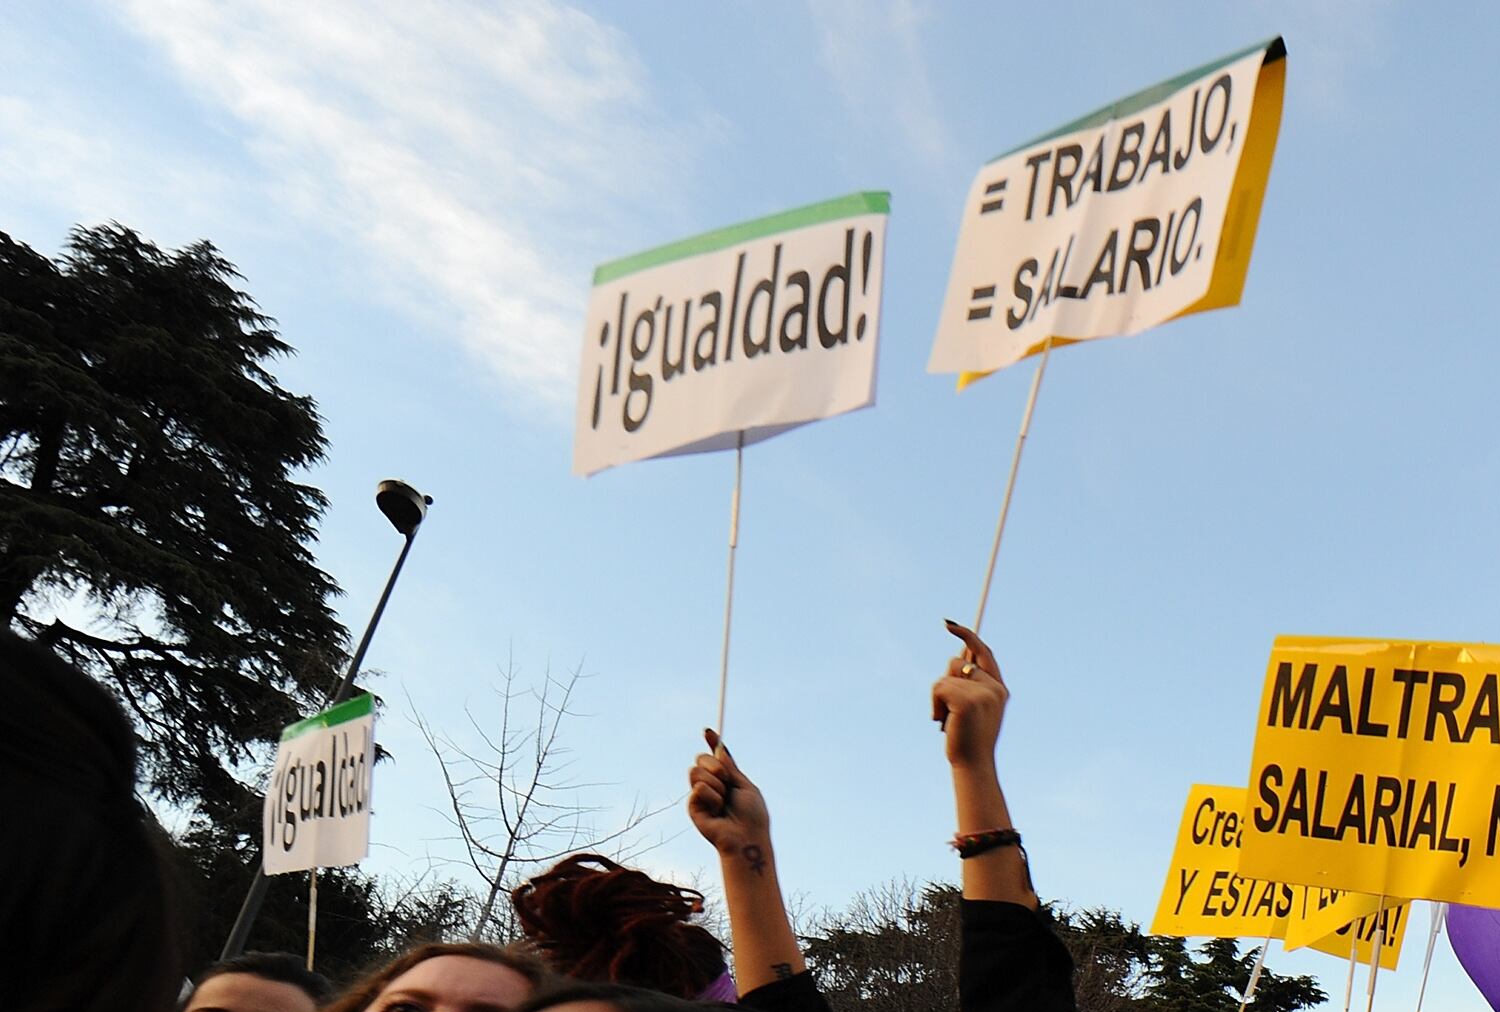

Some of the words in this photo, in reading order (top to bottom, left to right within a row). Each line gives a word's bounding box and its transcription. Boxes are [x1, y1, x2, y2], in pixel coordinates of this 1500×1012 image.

[1024, 74, 1238, 220] TRABAJO,
[1006, 197, 1202, 330] SALARIO.
[591, 229, 872, 432] ¡Igualdad!
[1254, 764, 1470, 868] SALARIAL,
[1174, 869, 1200, 915] Y
